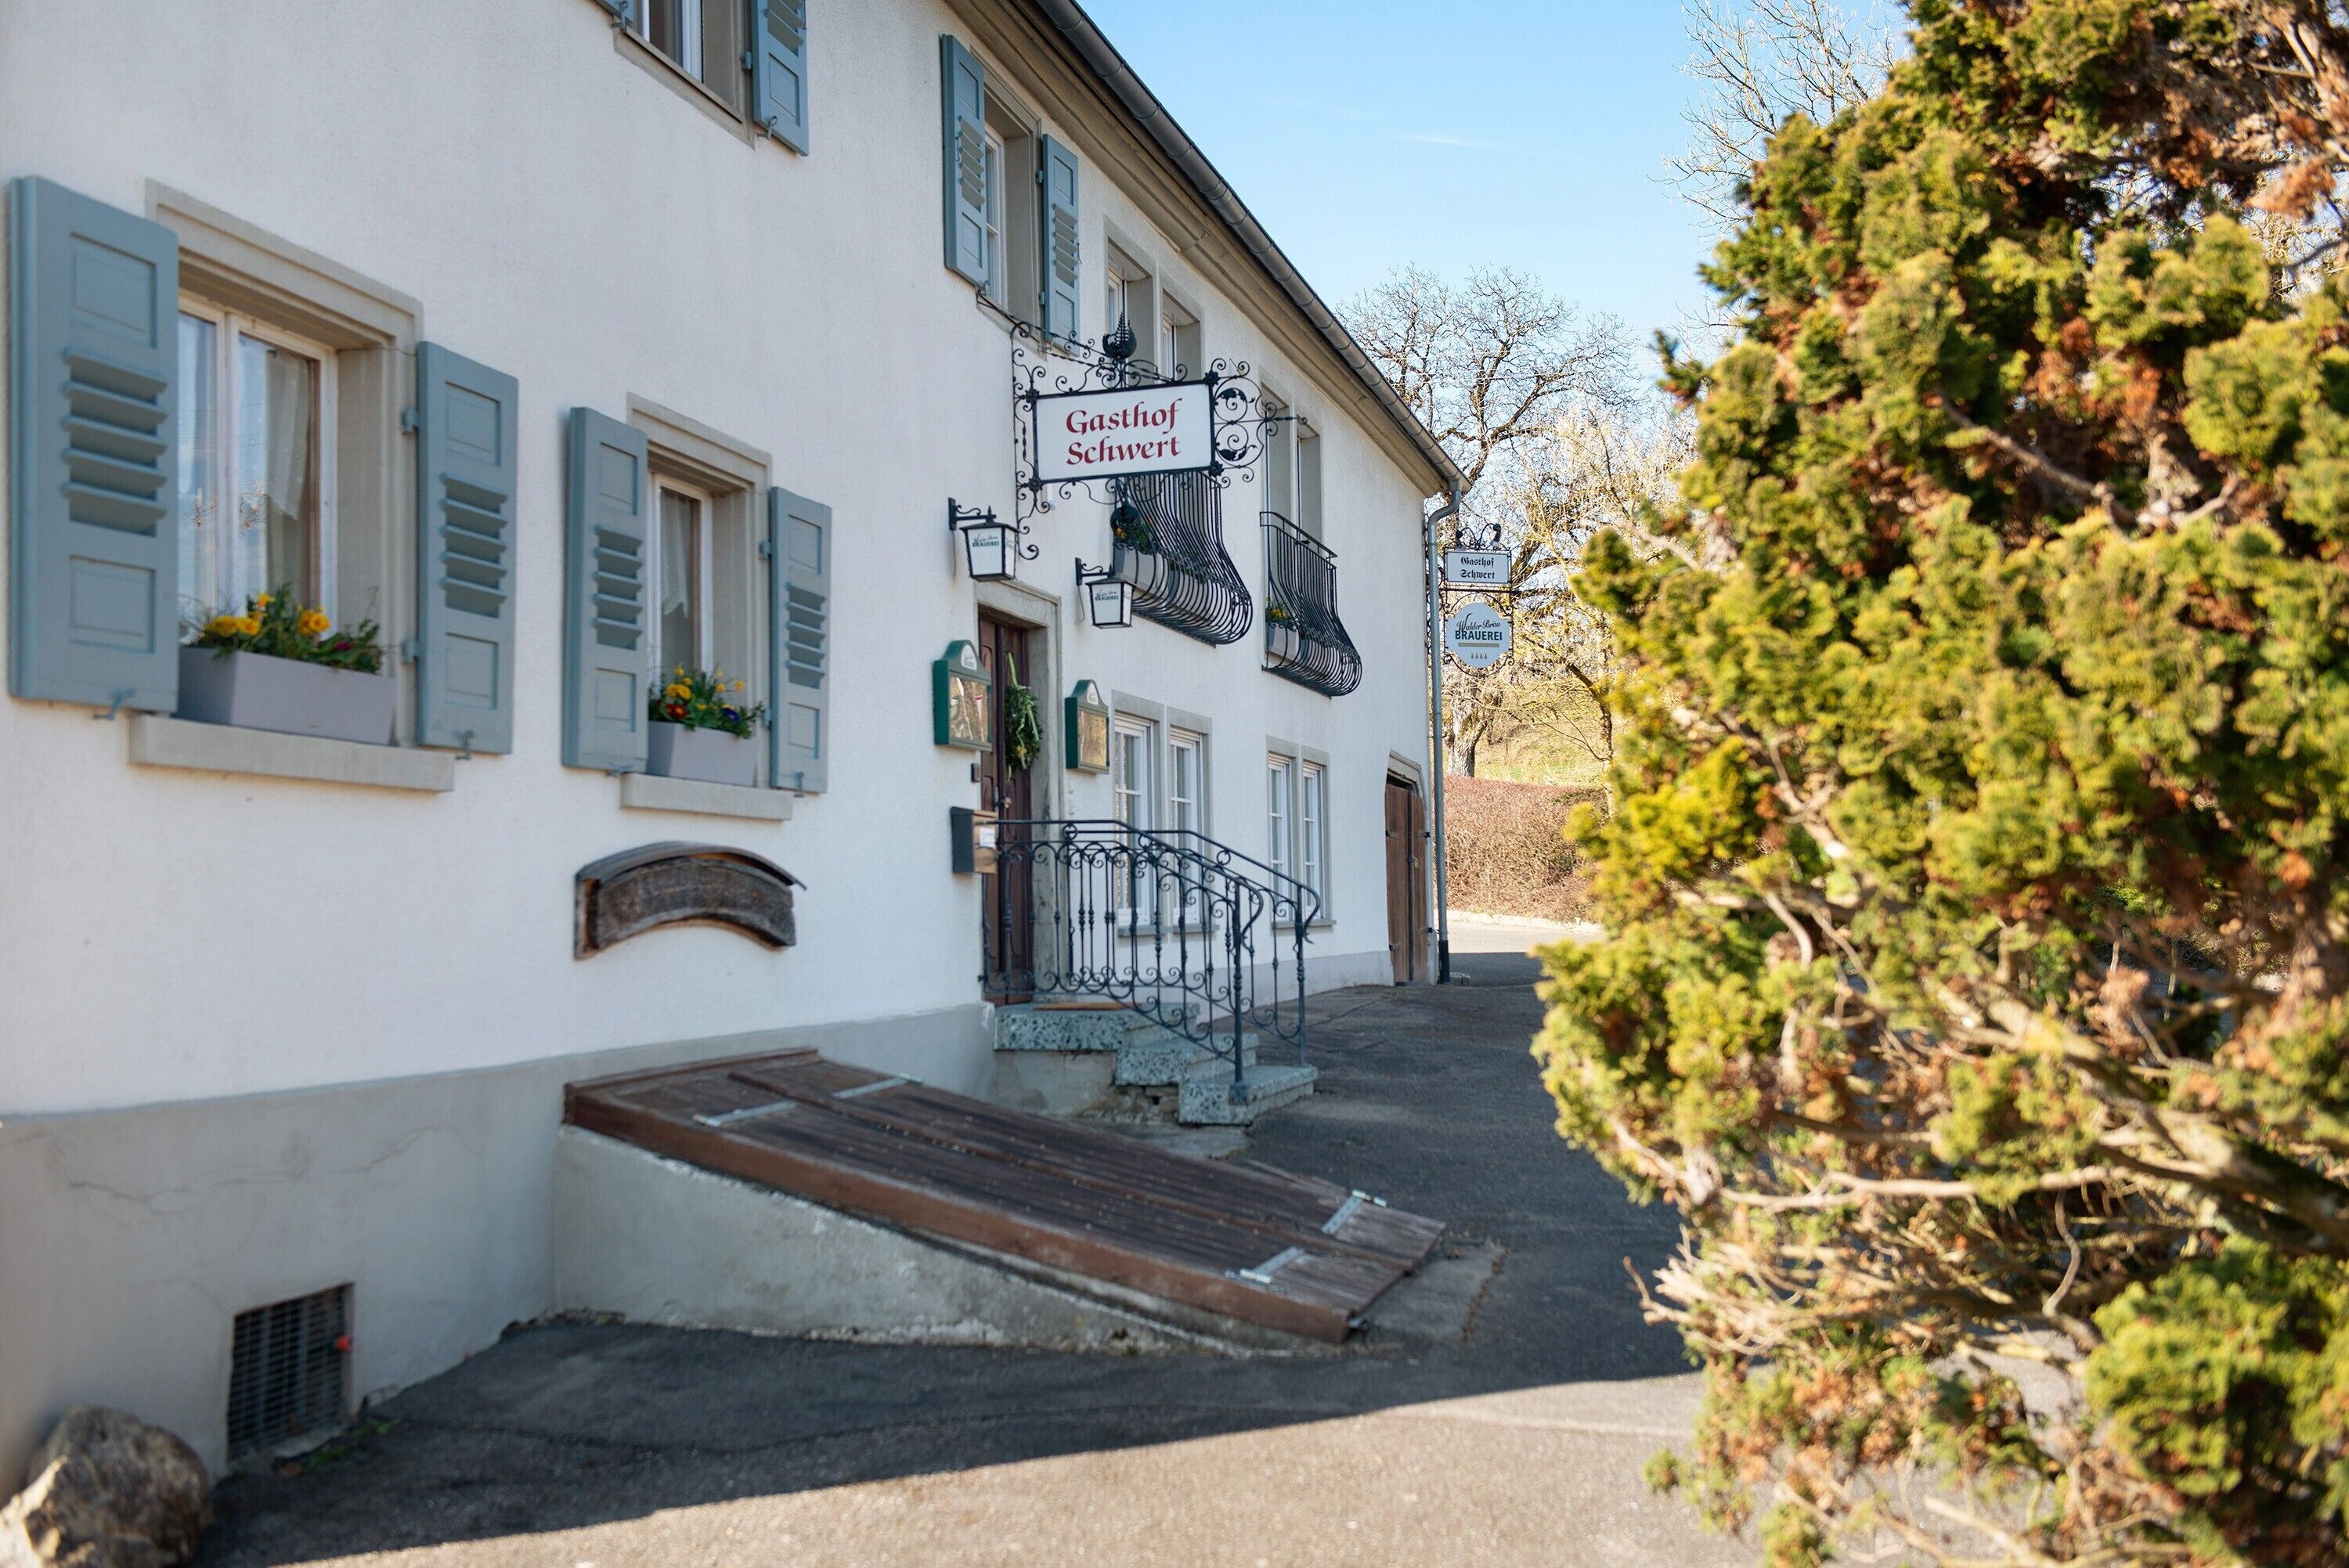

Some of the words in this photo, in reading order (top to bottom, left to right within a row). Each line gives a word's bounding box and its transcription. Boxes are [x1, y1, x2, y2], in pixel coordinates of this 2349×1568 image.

[1066, 398, 1182, 434] Gasthof
[1066, 436, 1182, 465] Schwert
[1460, 556, 1495, 568] Gasthof
[1460, 569, 1496, 580] Schwert
[1456, 613, 1482, 632] Walder
[1455, 630, 1503, 641] BRAUEREI
